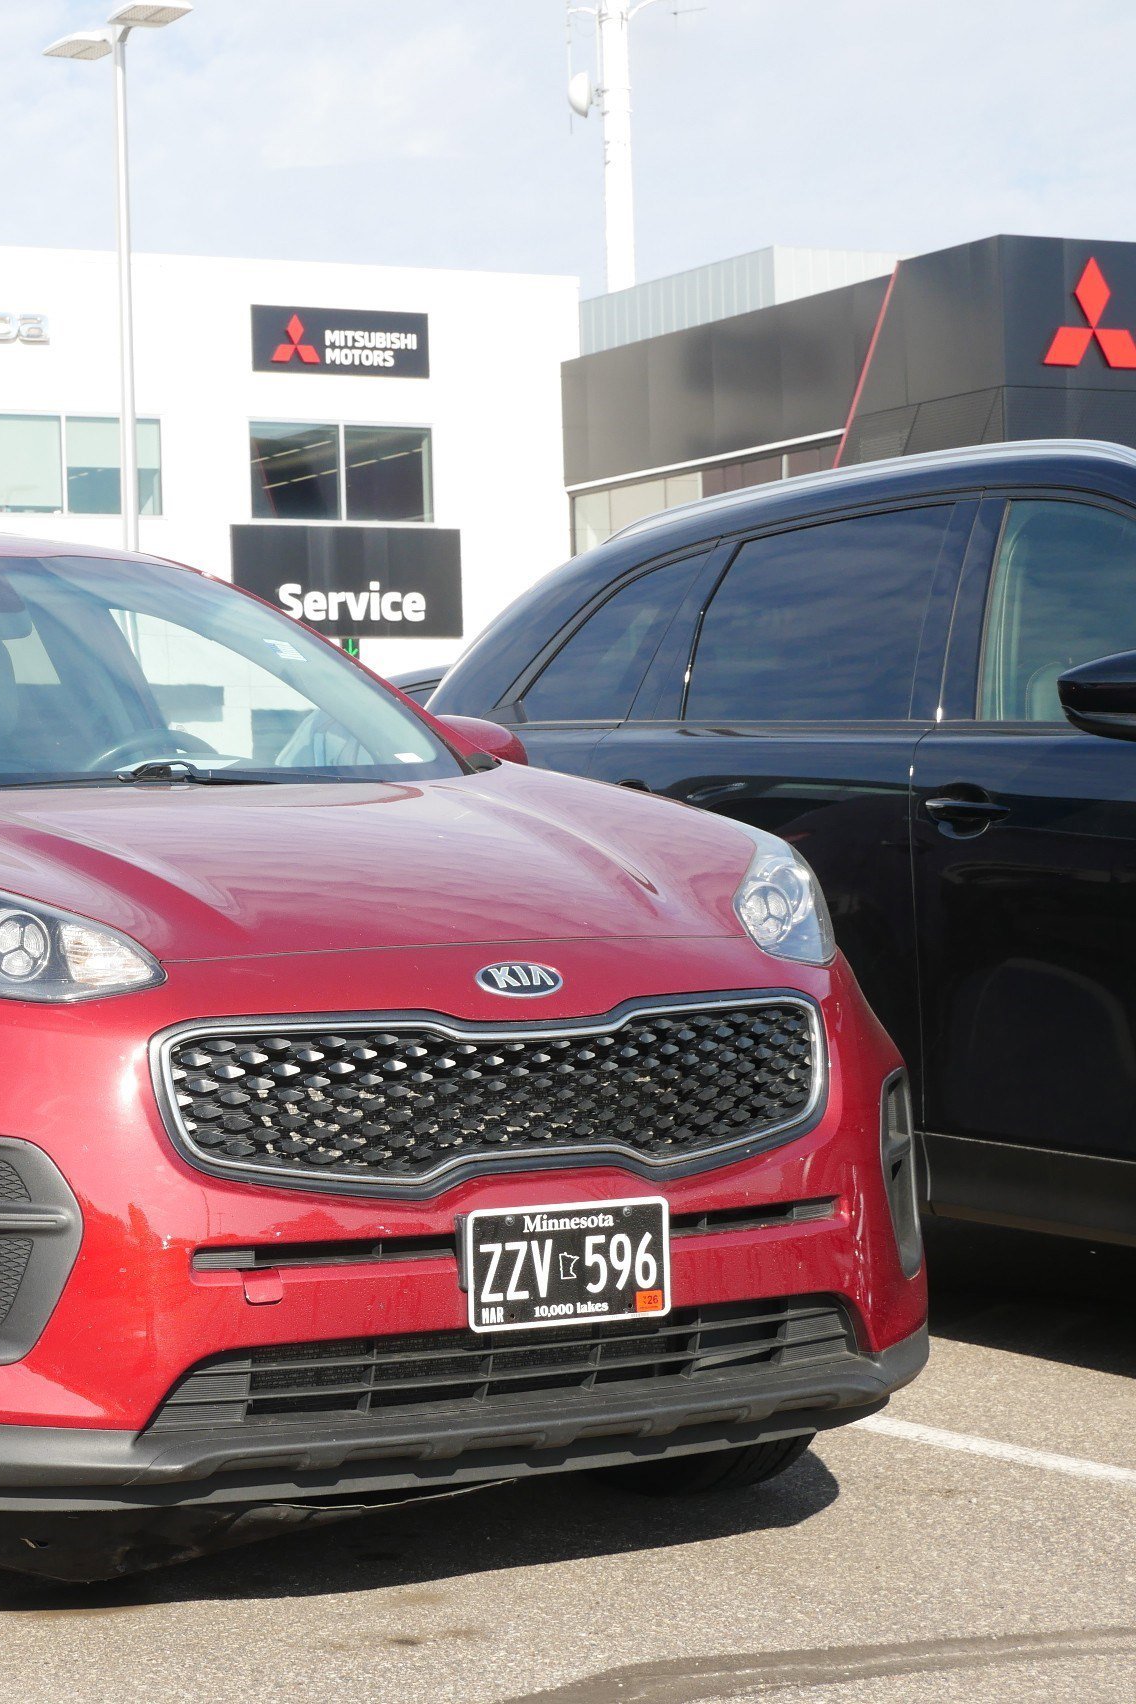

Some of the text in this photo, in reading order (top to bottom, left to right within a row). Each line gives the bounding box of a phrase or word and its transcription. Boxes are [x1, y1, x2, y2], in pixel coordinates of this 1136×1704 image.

[324, 329, 417, 349] MITSUBISHI
[325, 348, 394, 367] MOTORS
[277, 581, 426, 621] Service
[487, 966, 555, 988] KIA
[523, 1213, 614, 1233] Minnesota
[480, 1231, 657, 1303] ZZV 596
[482, 1307, 504, 1324] MAR
[533, 1301, 609, 1317] 10,000 lakes
